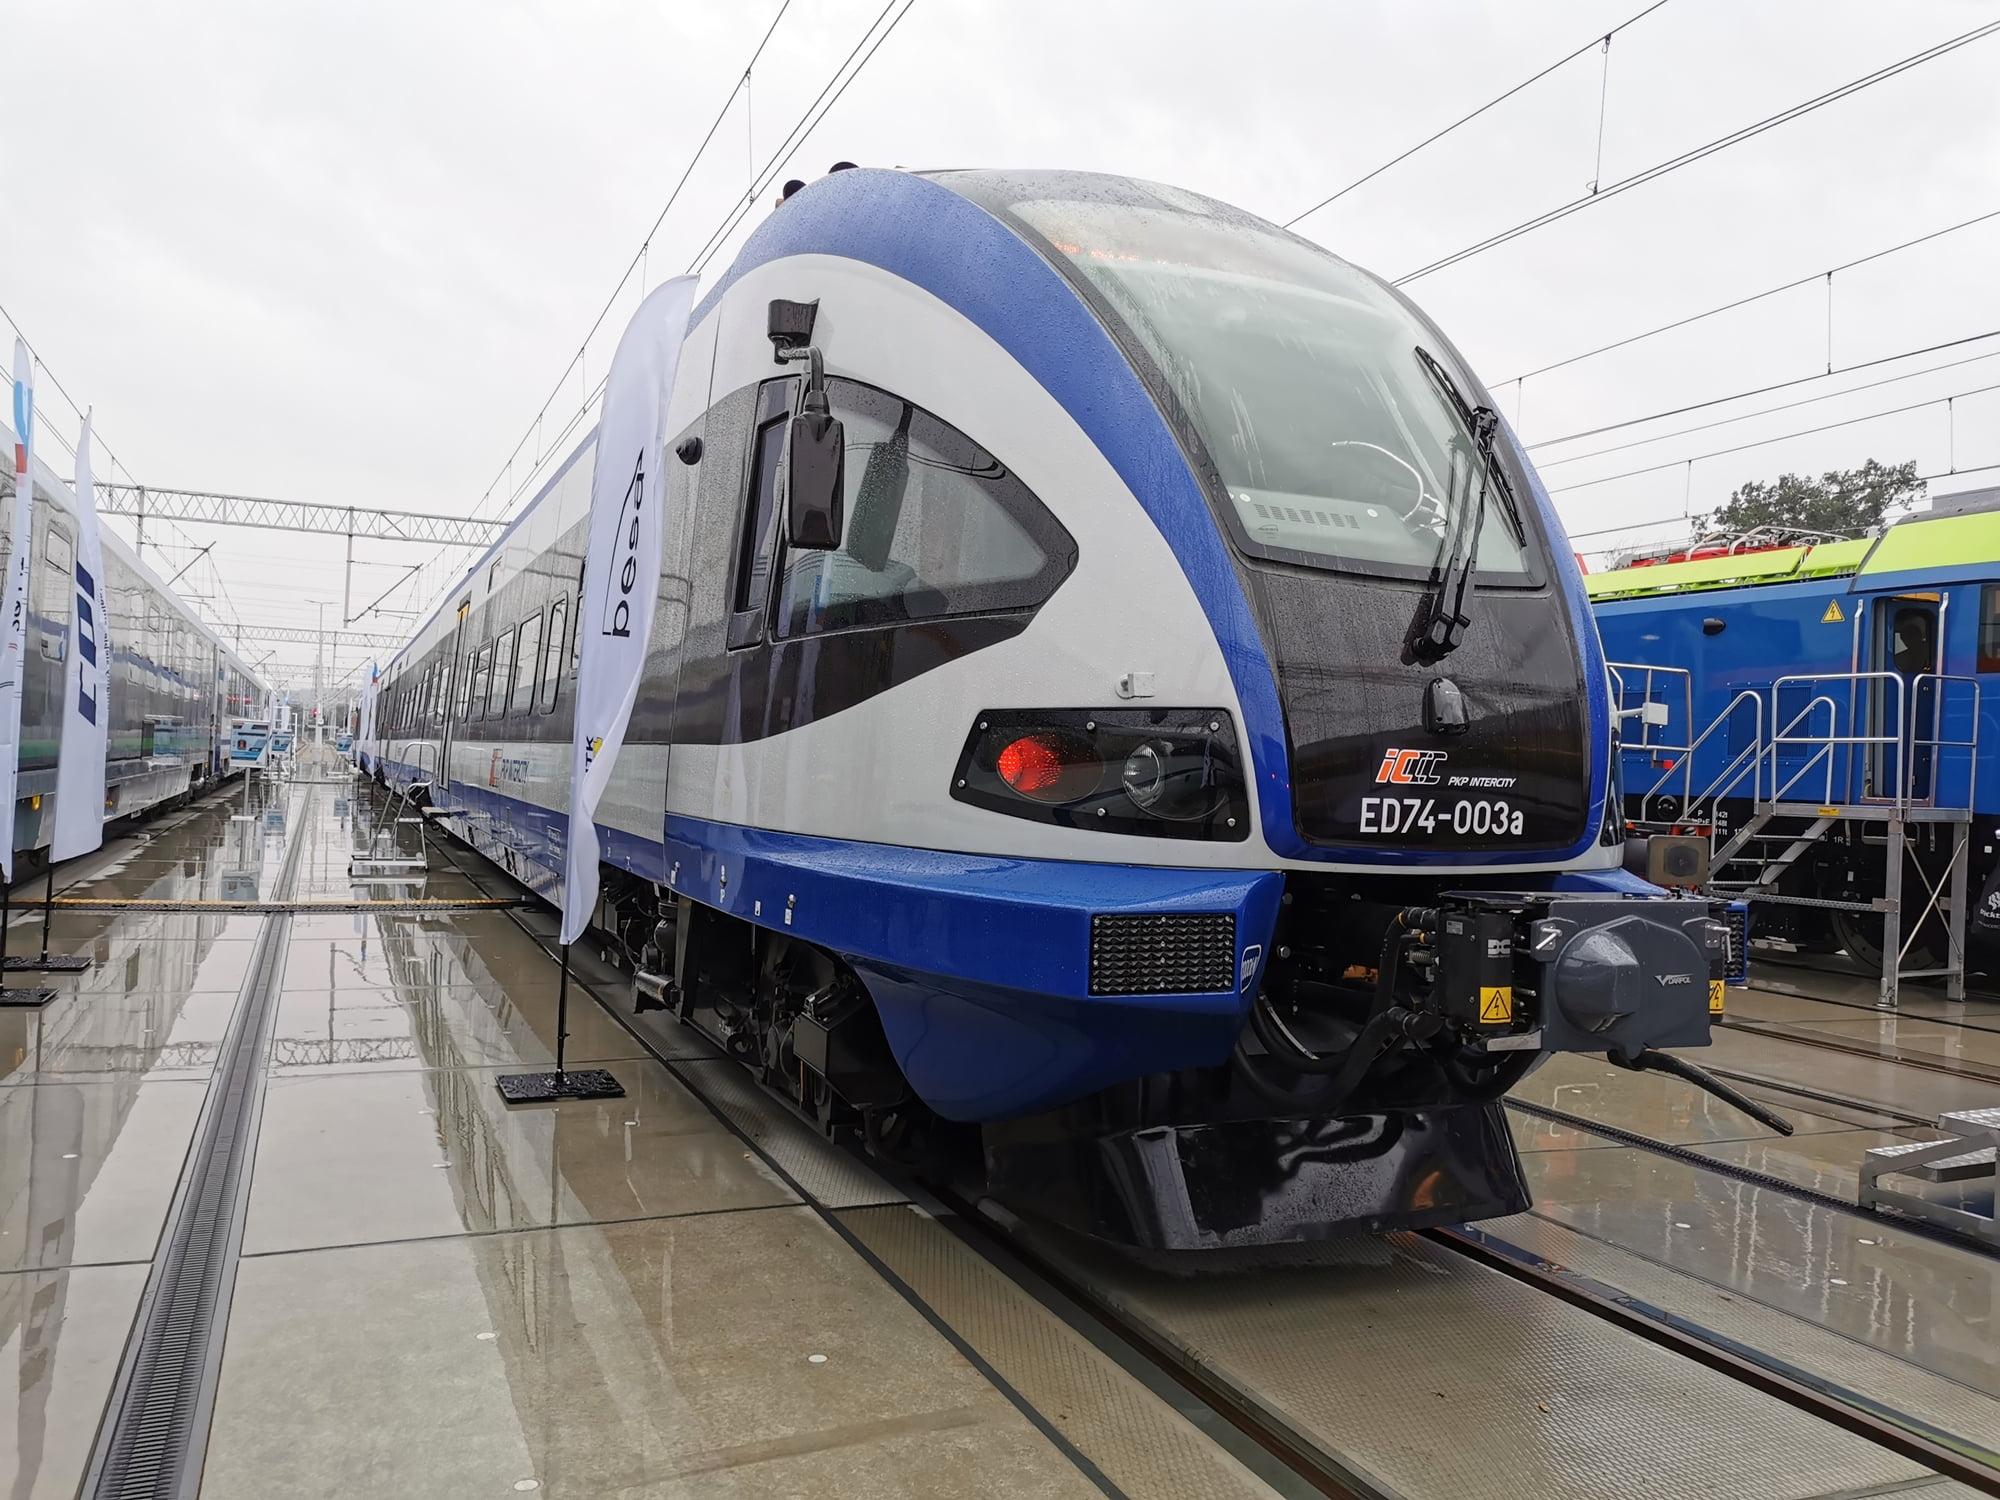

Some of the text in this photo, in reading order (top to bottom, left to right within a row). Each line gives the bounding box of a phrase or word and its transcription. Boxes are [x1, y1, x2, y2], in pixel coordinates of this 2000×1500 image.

[611, 471, 645, 638] pesa
[1448, 776, 1517, 788] PKP INTERCITY
[1359, 797, 1524, 835] ED74-003a
